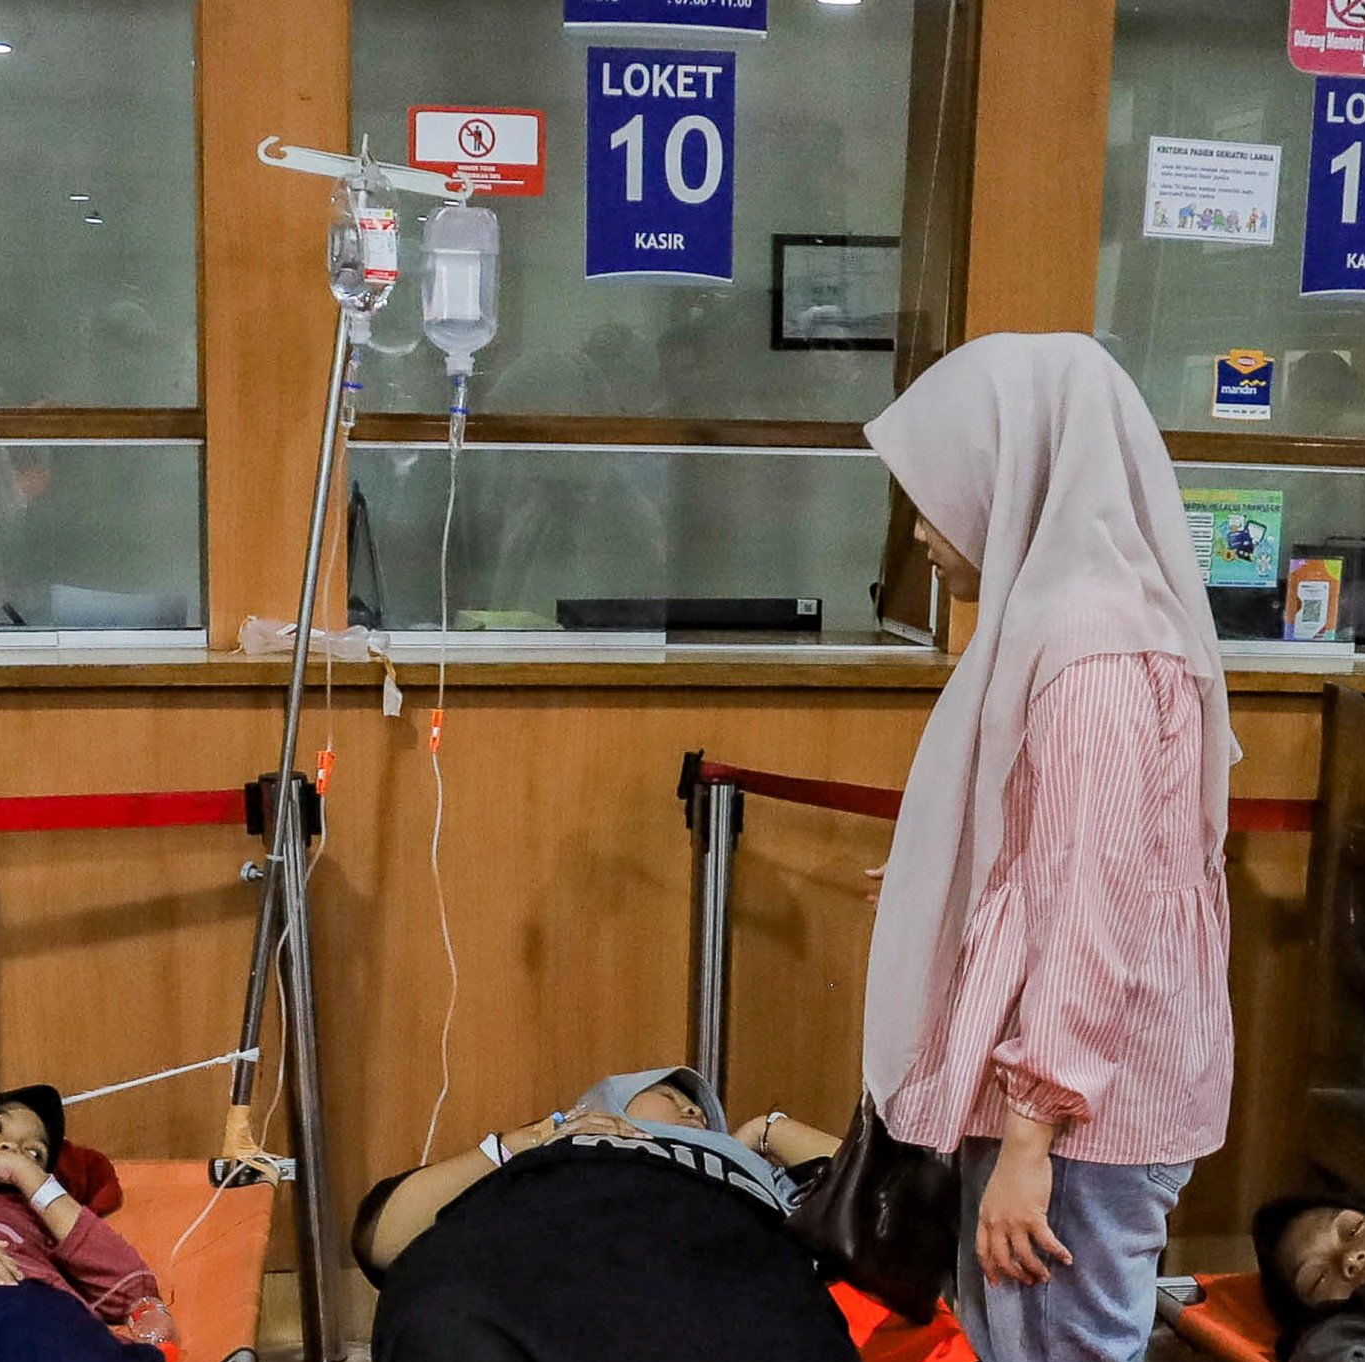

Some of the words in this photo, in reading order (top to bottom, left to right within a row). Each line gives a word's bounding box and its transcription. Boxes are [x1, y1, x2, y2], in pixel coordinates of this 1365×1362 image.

[602, 62, 722, 99] LOKET
[610, 114, 723, 204] 10
[635, 232, 684, 250] KASIR
